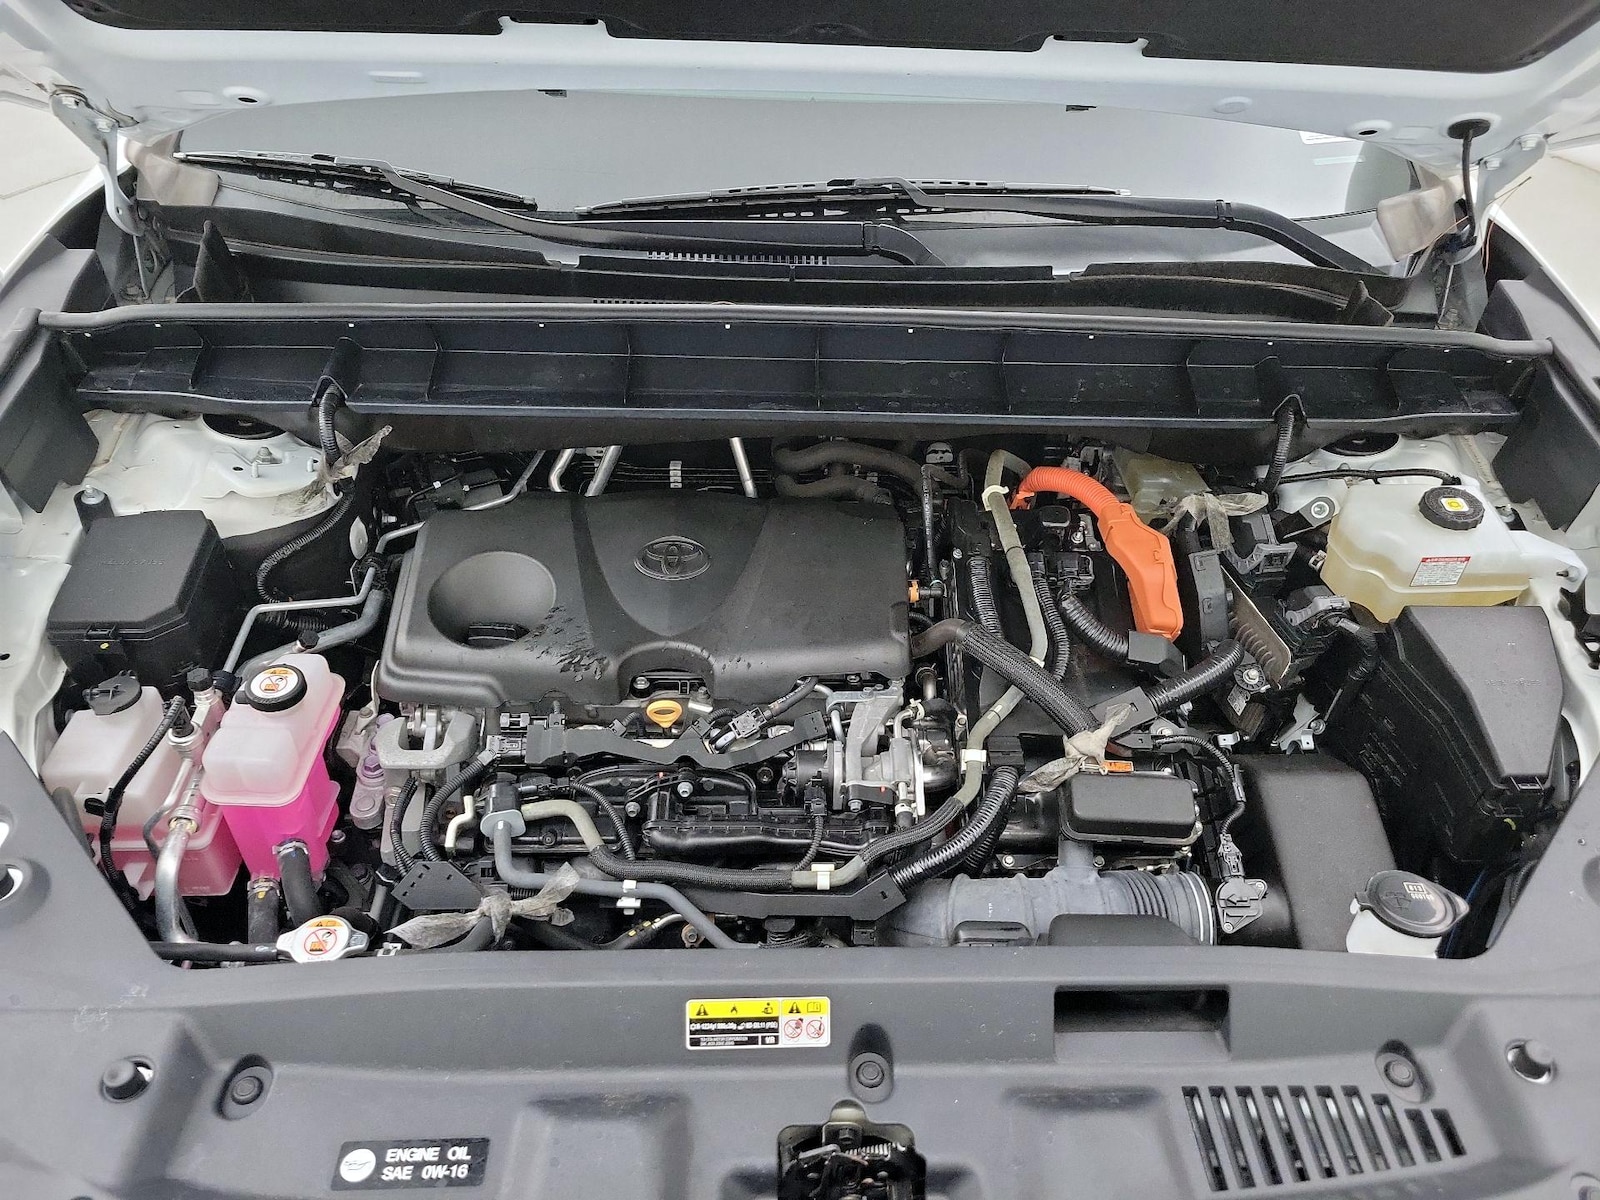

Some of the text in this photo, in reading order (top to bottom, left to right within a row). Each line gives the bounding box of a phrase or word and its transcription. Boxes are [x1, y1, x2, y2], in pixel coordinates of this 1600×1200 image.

[385, 1146, 471, 1162] ENGINE OIL
[381, 1164, 469, 1181] SAE 0W-16
